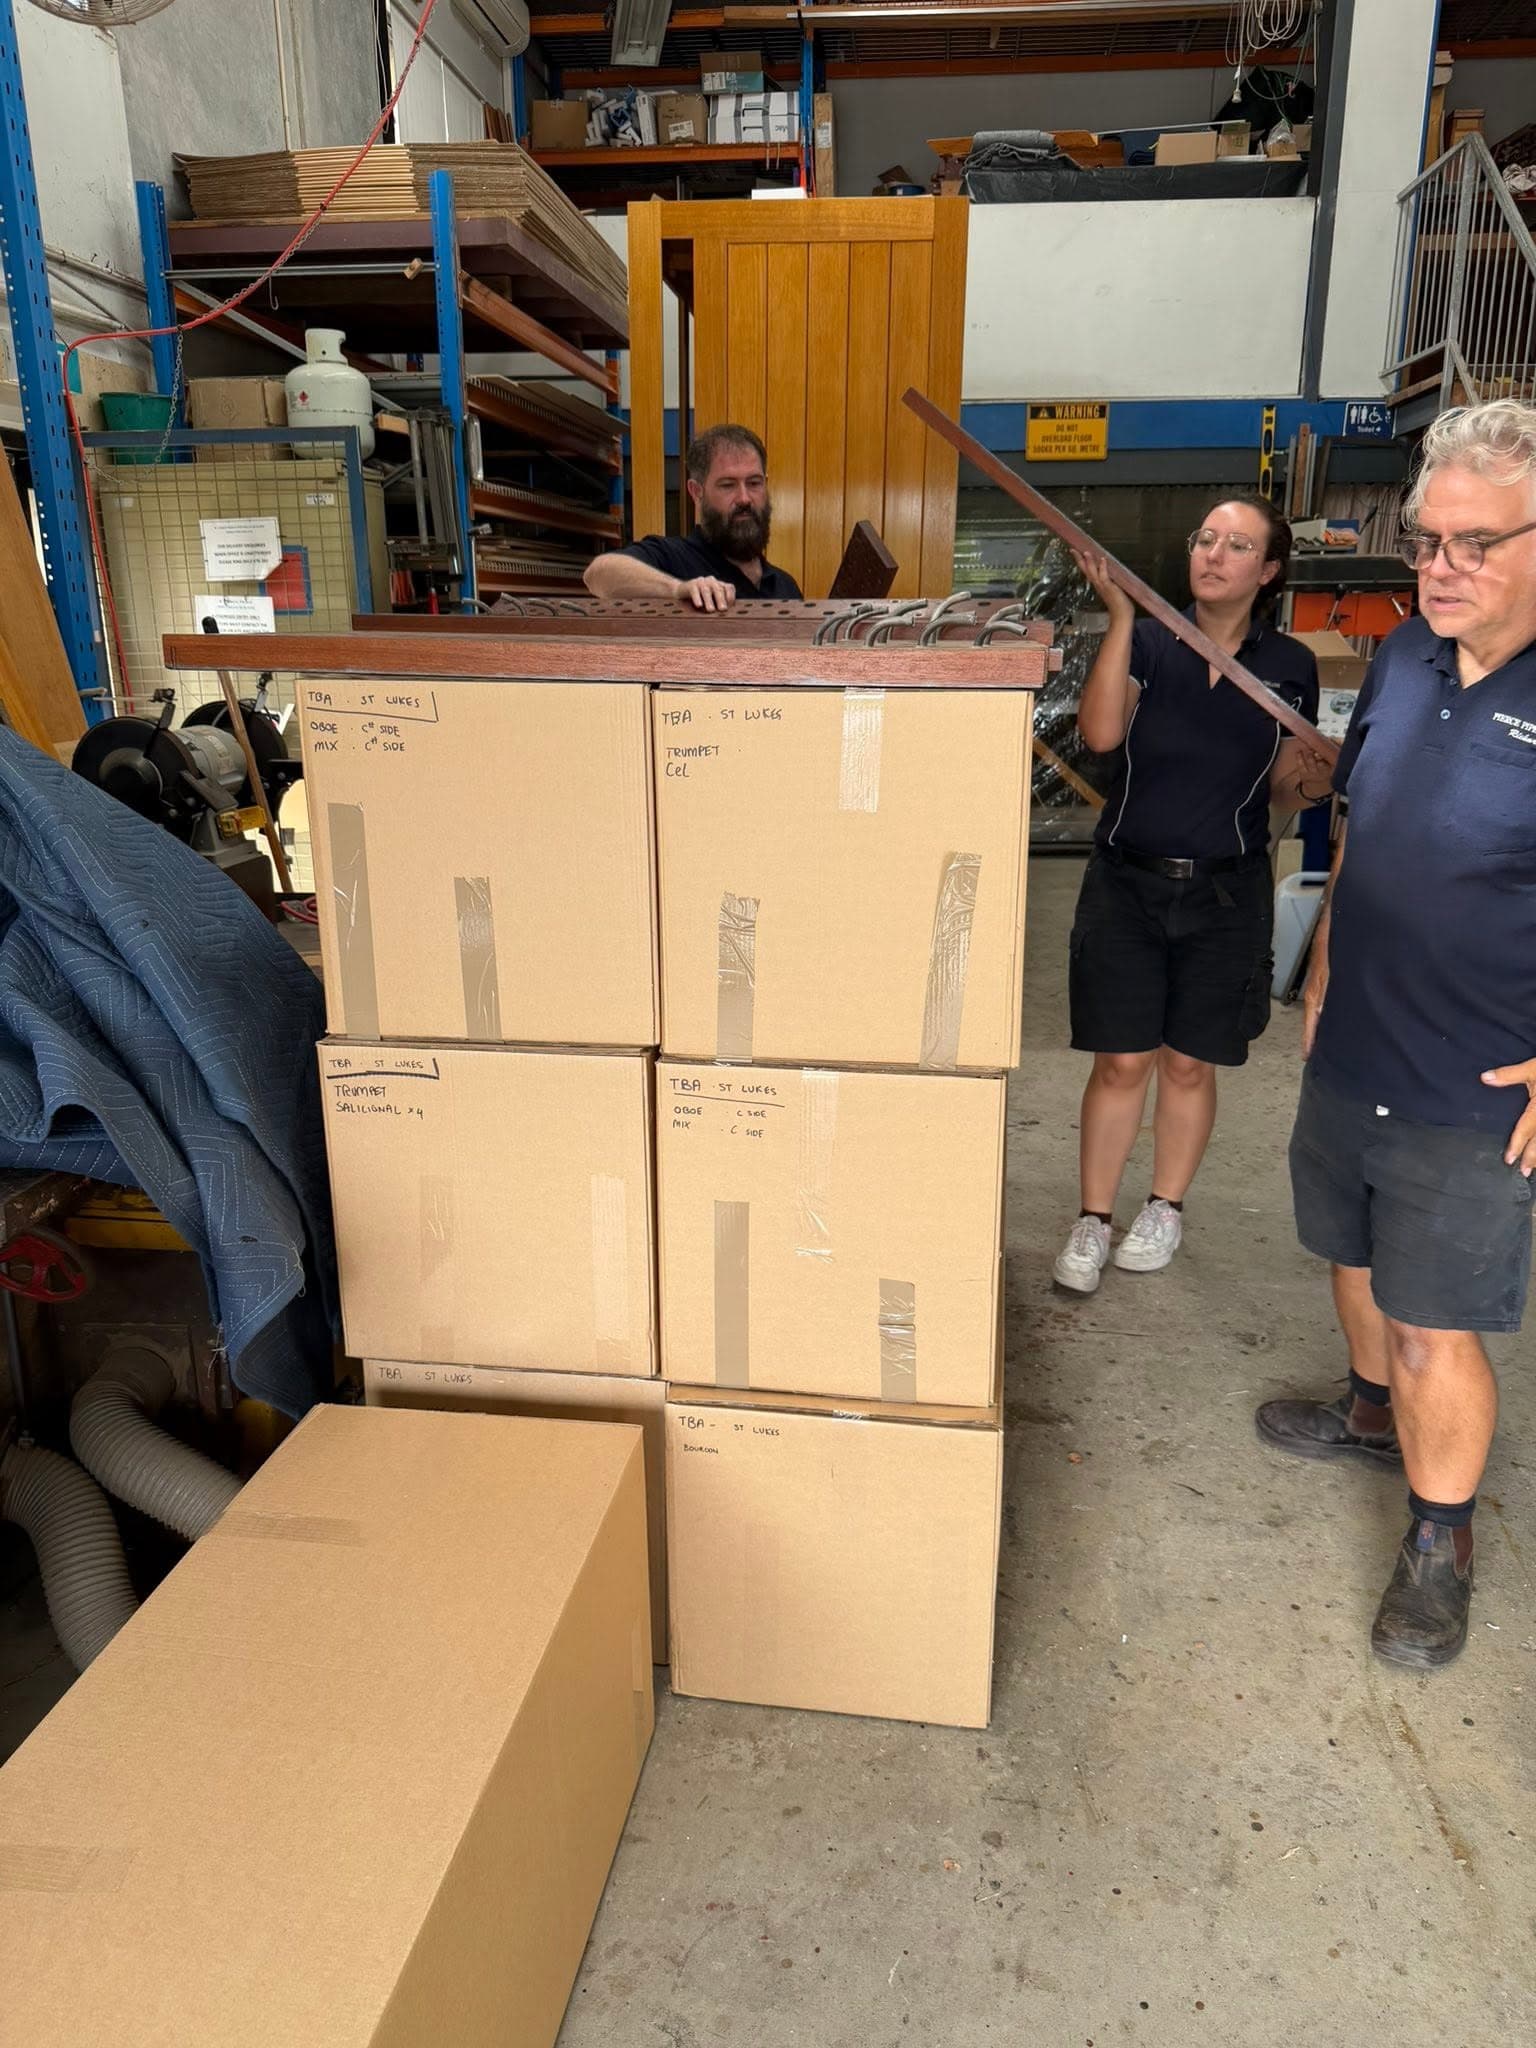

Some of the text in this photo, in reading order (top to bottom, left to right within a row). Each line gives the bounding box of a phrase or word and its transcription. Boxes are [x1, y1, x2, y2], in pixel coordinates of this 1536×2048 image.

[1055, 404, 1100, 418] WARNING
[1067, 424, 1078, 432] NOT
[1041, 434, 1072, 442] OVERLOAD
[308, 691, 420, 708] TBA ST LUKES
[662, 708, 782, 726] TBA ST LUKES
[311, 721, 338, 734] OBOE
[380, 725, 401, 737] SIDE
[315, 740, 338, 752] MIX
[383, 742, 405, 751] SIDE
[666, 745, 720, 758] TRUMPET
[329, 1059, 424, 1069] TBA ST LUKES
[334, 1084, 386, 1097] TRUMPET
[670, 1079, 777, 1096] TBA ST LUKES
[673, 1106, 702, 1116] OBOE
[747, 1110, 767, 1118] SIDE
[672, 1120, 765, 1138] MIX C SIDE
[379, 1367, 473, 1384] TBA ST LUKES
[678, 1416, 704, 1429] TBA
[752, 1426, 780, 1436] LUKES
[683, 1444, 719, 1454] BOURDON
